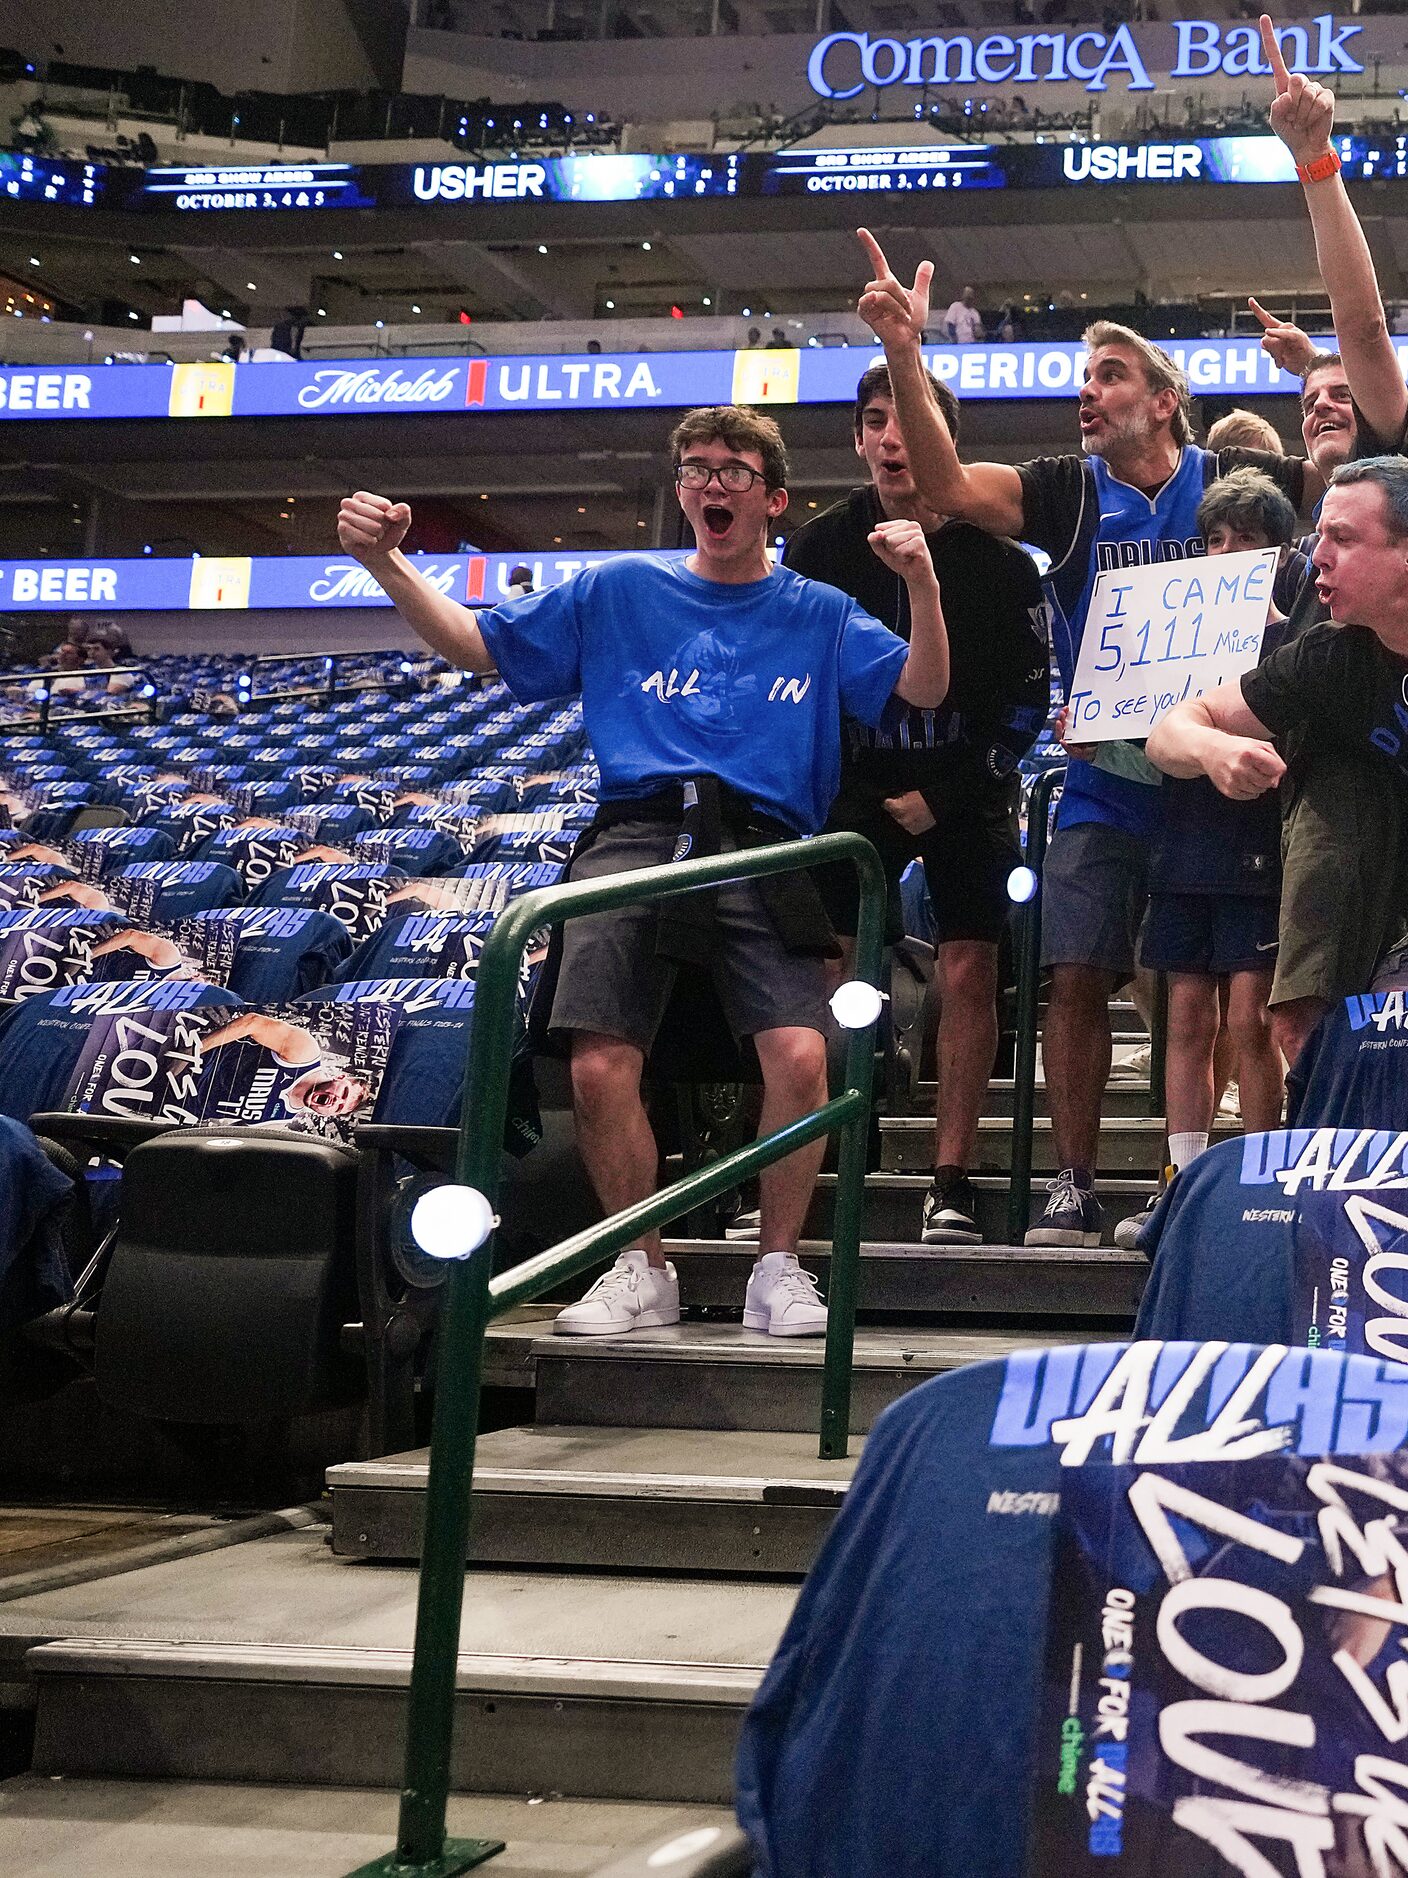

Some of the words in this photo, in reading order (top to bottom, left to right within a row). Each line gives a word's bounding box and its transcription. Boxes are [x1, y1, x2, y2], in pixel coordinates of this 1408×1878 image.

[1171, 13, 1364, 78] Bank
[1063, 145, 1202, 180] USHER
[414, 164, 545, 200] USHER
[807, 174, 892, 190] OCTOBER
[918, 174, 929, 187] 4
[933, 173, 947, 187] &
[952, 173, 961, 186] 5
[176, 192, 257, 210] OCTOBER
[299, 366, 461, 406] Michelob
[13, 568, 117, 602] BEER
[1105, 586, 1133, 618] I
[1162, 564, 1267, 610] CAME
[1095, 612, 1206, 682] 5,111
[640, 670, 700, 705] ALL
[767, 672, 811, 705] IN
[1330, 1257, 1349, 1294] ONE
[1328, 1304, 1348, 1339] FOR
[1101, 1588, 1135, 1652] ONE
[1097, 1678, 1130, 1742] FOR
[1057, 1717, 1084, 1796] chime
